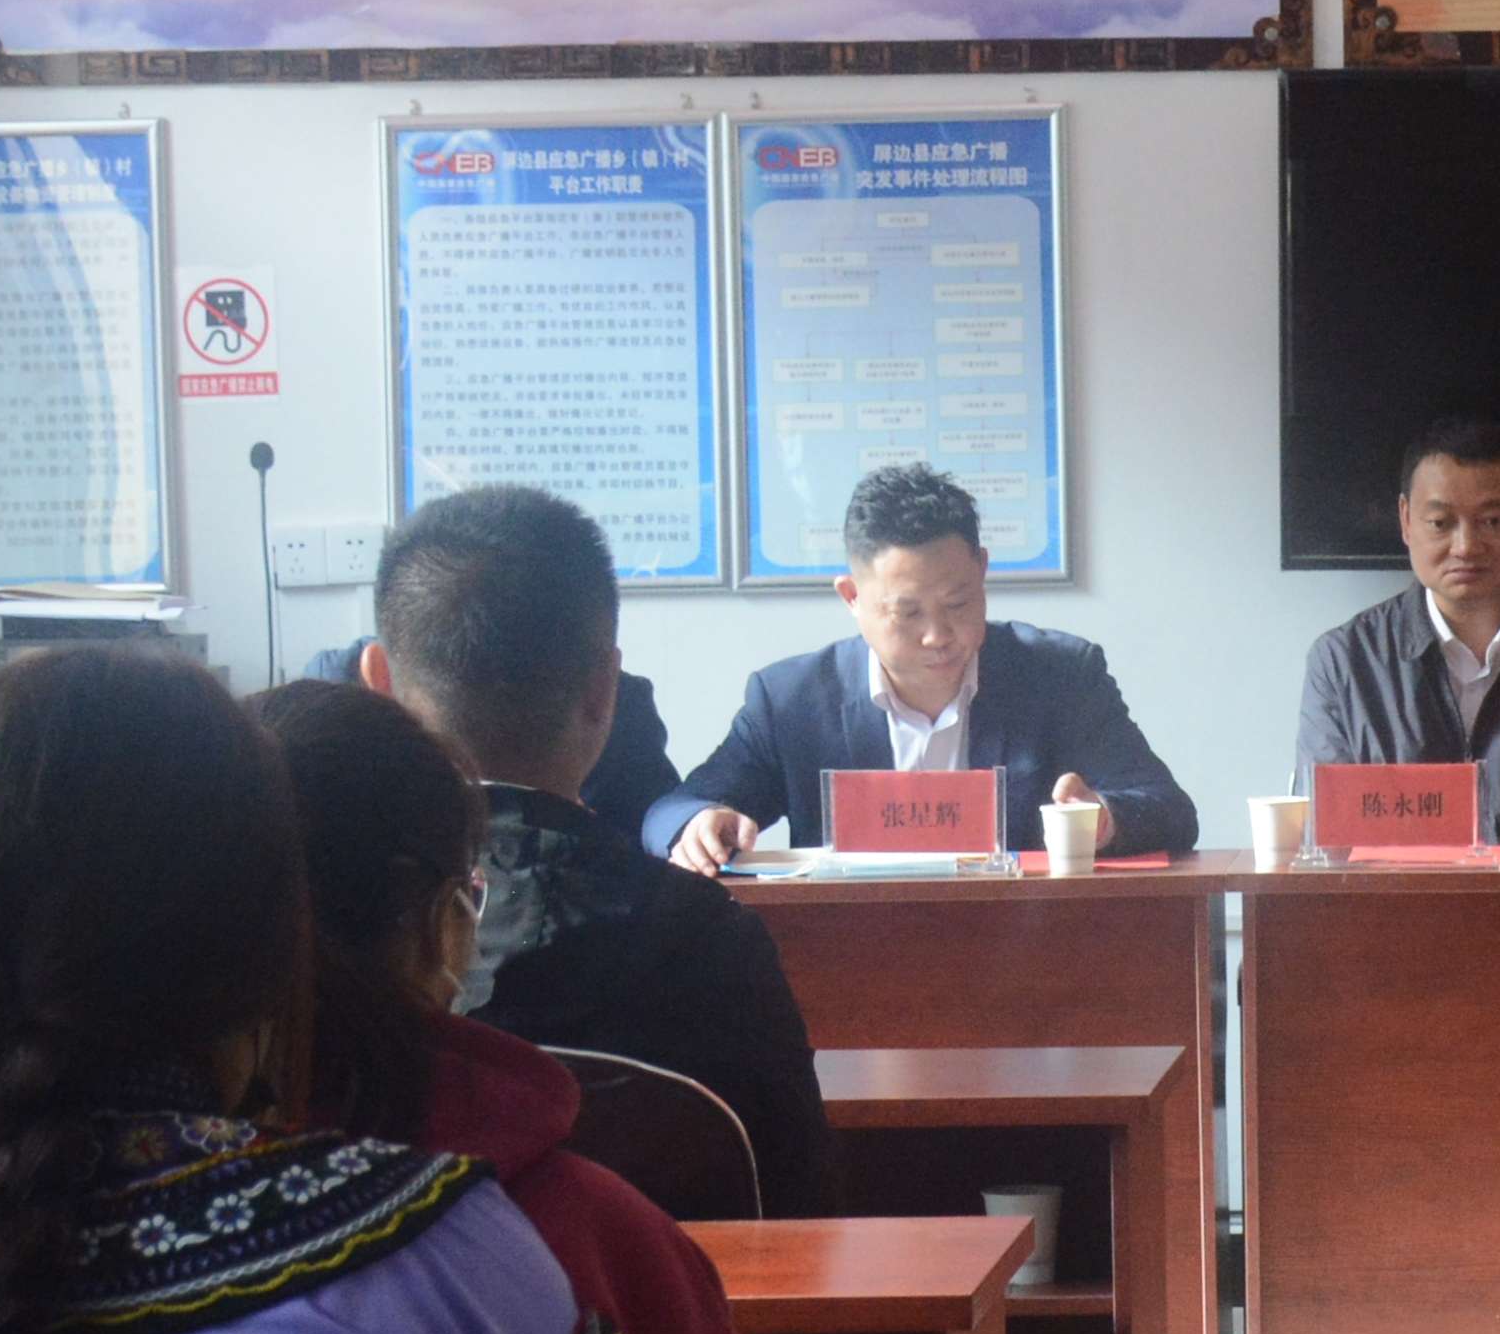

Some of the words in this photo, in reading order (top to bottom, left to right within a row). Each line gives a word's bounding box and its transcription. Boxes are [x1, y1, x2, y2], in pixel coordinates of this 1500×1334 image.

[873, 142, 1008, 164] 屏边县应急广播
[855, 166, 1029, 189] 突发事件处理流程图
[880, 800, 962, 828] 张星辉
[1361, 792, 1444, 819] 陈永刚
